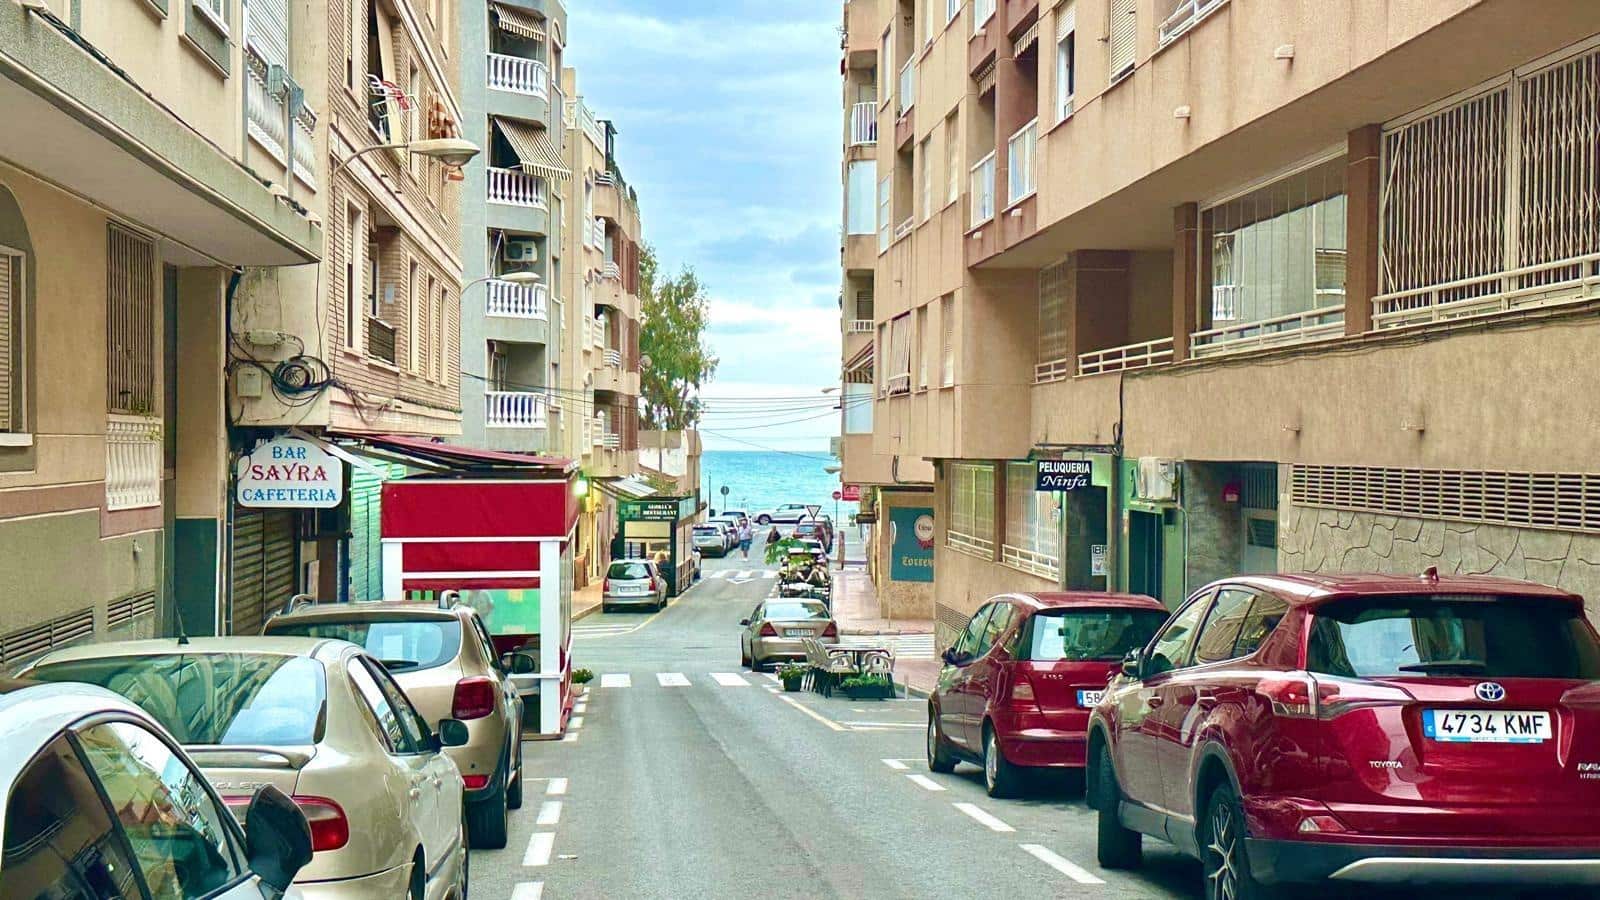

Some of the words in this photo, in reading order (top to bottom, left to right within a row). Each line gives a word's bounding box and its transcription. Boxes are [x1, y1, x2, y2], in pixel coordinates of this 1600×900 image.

[272, 446, 307, 459] BAR
[251, 462, 328, 482] SAYRA
[1038, 461, 1091, 474] PELUQUERIA
[1040, 474, 1088, 490] Ninfa
[242, 488, 337, 502] CAFETERIA
[1085, 692, 1105, 704] 58
[1441, 713, 1497, 734] 4734
[1503, 714, 1545, 735] KMF
[1368, 760, 1403, 769] TOYOTA
[1577, 762, 1600, 771] RAV
